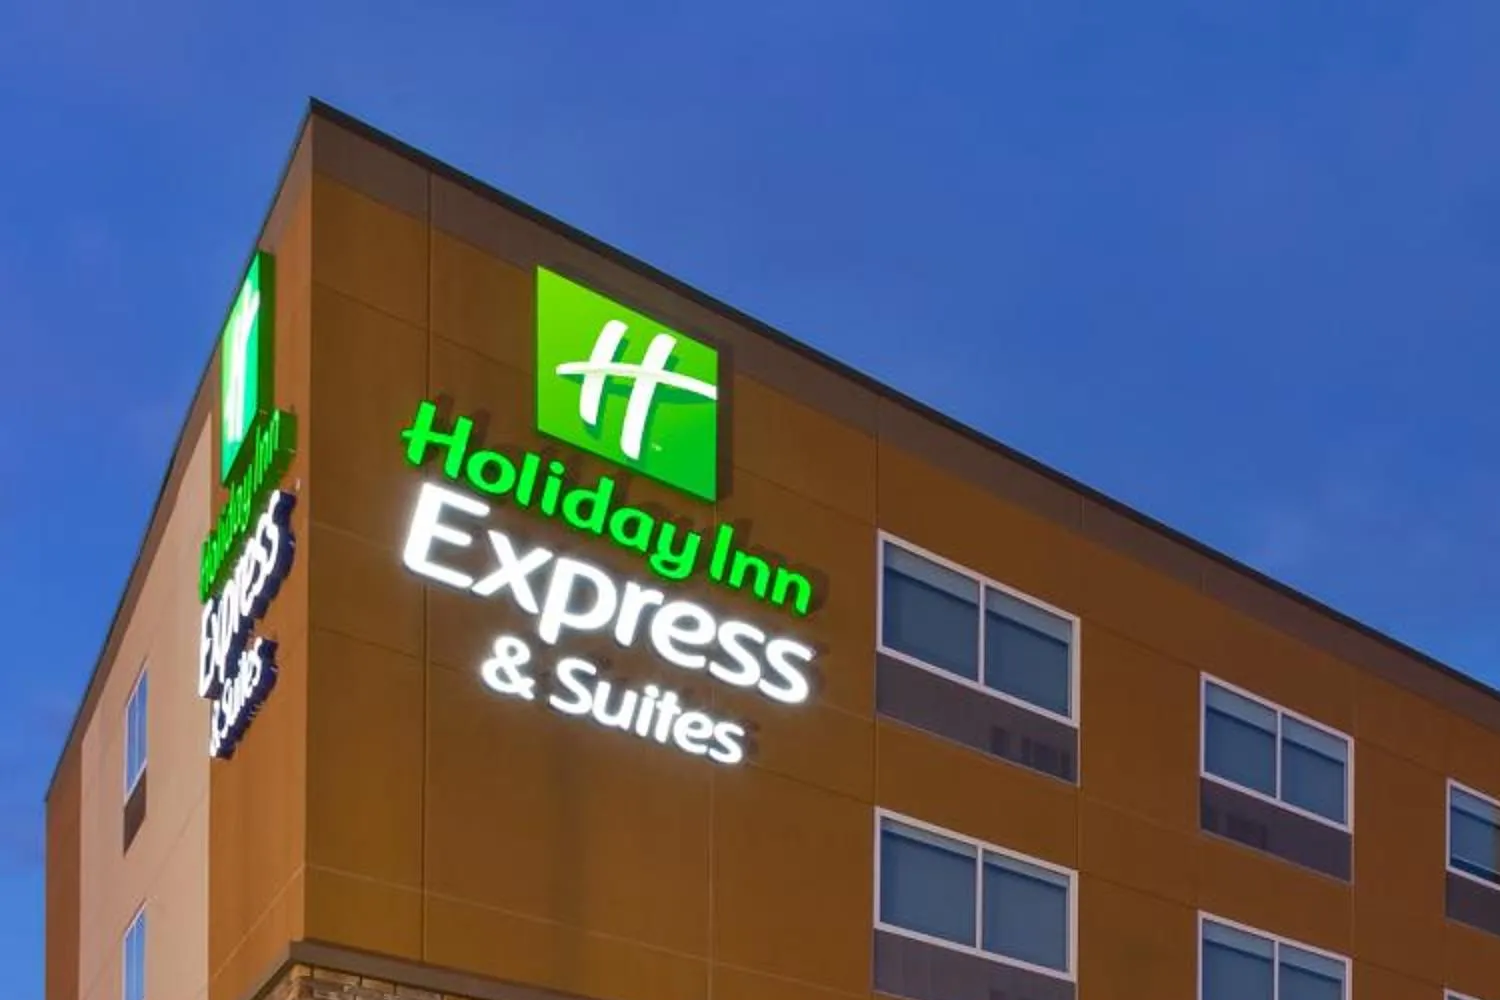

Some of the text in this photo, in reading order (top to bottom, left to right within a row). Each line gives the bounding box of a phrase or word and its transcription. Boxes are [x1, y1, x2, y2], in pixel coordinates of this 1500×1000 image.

[198, 489, 281, 699] Express
[401, 401, 811, 614] Holiday Inn
[402, 481, 815, 704] Express
[481, 634, 746, 764] & Suites
